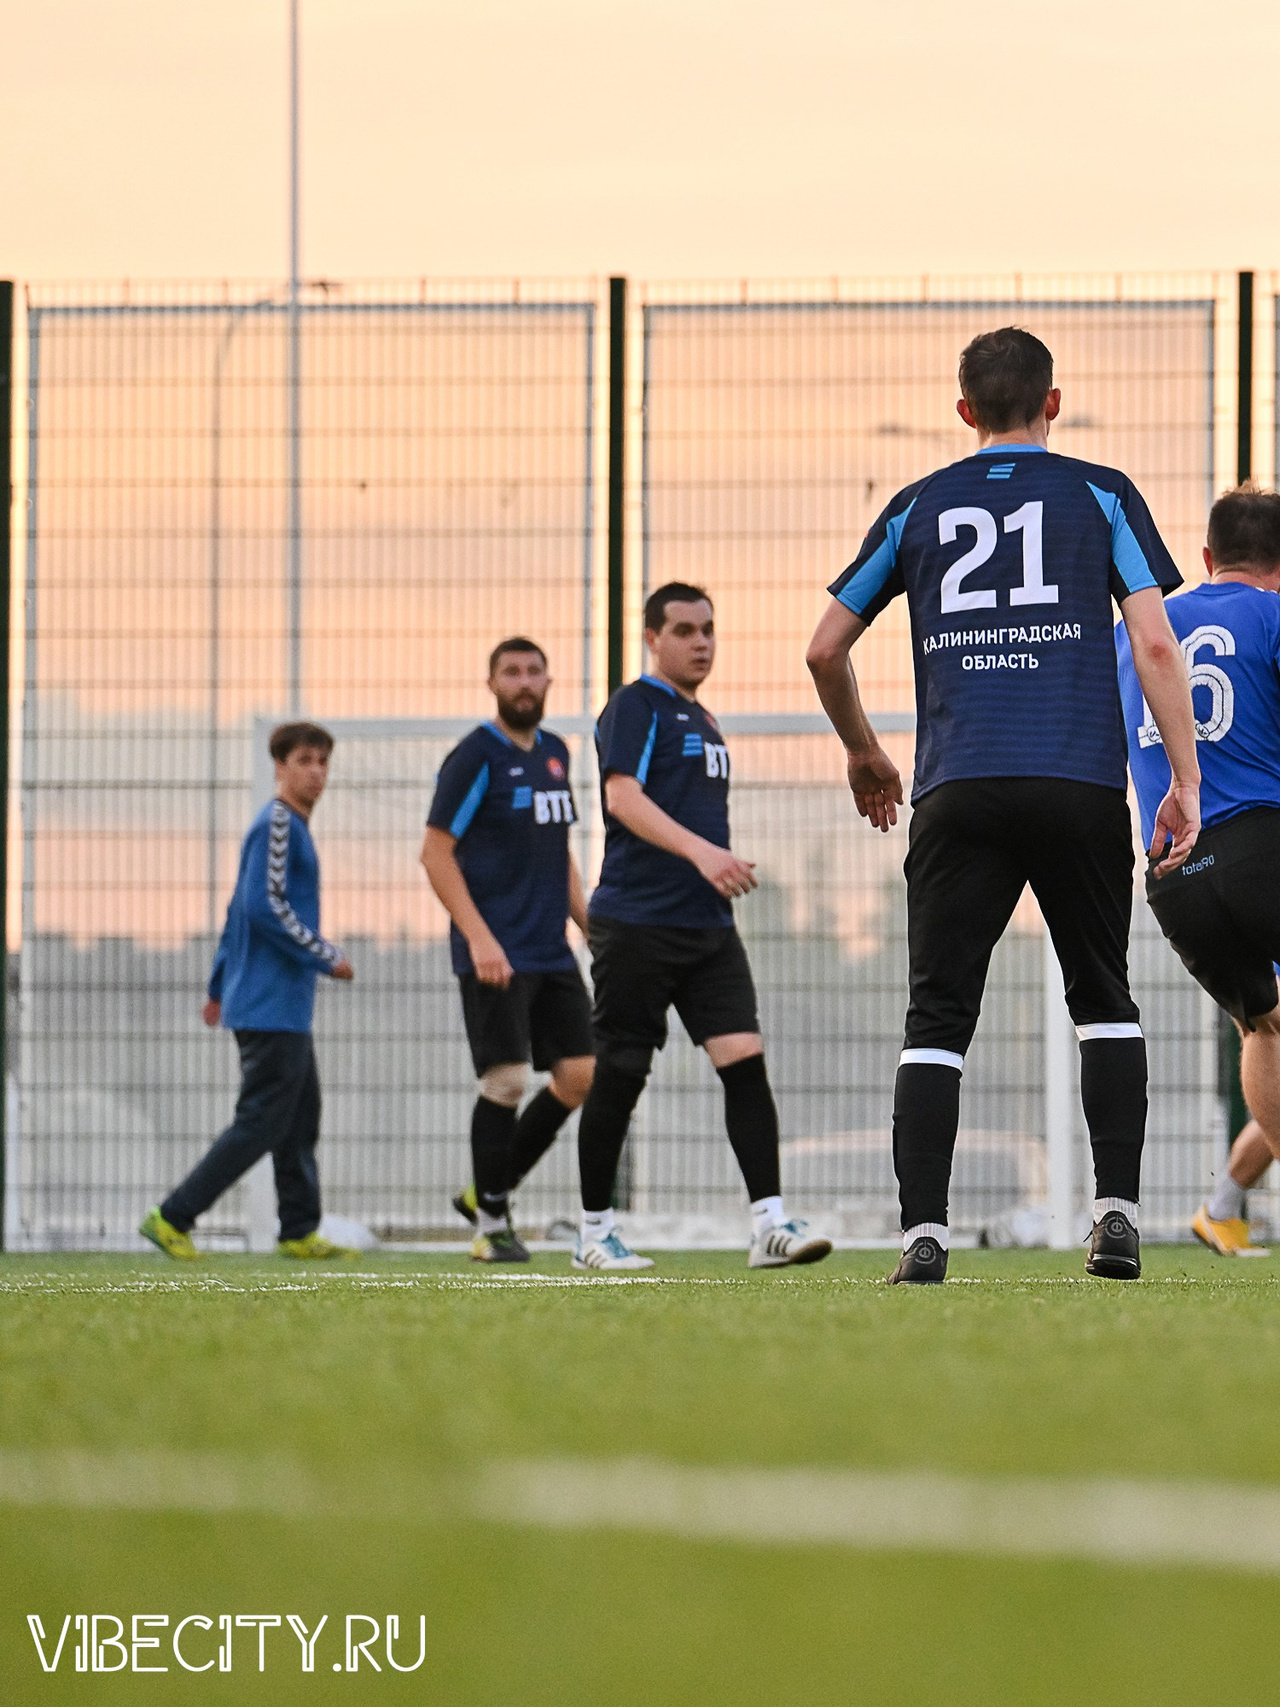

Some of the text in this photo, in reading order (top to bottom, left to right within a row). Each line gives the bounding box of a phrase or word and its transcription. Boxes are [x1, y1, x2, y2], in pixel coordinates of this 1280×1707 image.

[938, 500, 1059, 614] 21
[922, 622, 1082, 656] КАЛИНИНГРАДСКАЯ
[961, 653, 1040, 671] ОБЛАСТЬ
